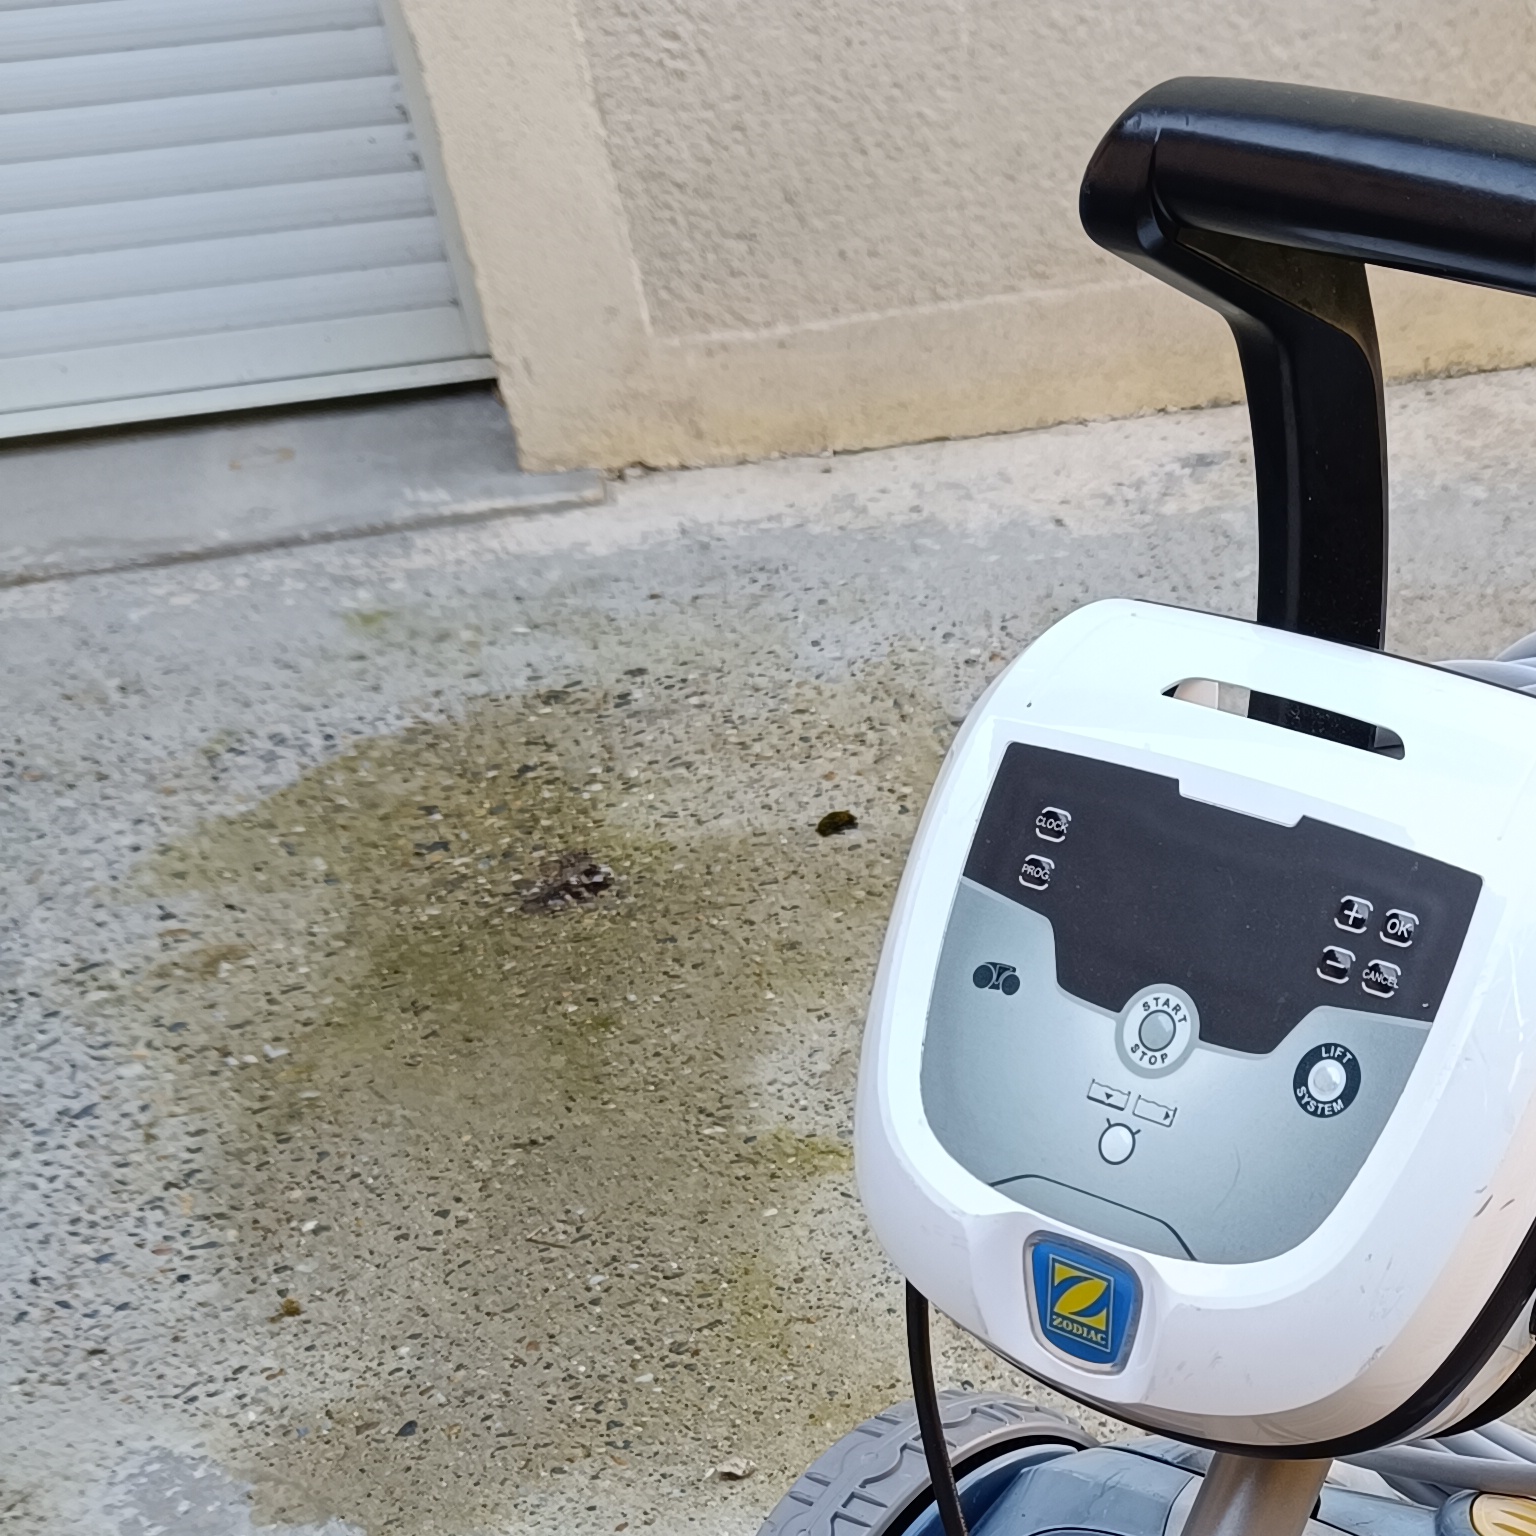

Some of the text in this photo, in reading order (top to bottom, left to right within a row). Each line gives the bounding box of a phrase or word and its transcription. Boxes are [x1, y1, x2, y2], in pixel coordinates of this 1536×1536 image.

[1035, 815, 1069, 833] CLOCK
[1021, 863, 1051, 882] PROG.
[1386, 918, 1413, 938] OK
[1362, 968, 1399, 989] CANCEL
[1142, 996, 1188, 1024] START
[1130, 1043, 1168, 1065] STOP
[1320, 1045, 1353, 1064] LIFT
[1296, 1086, 1344, 1116] SYSTEM
[1052, 1315, 1107, 1345] ZODIAC
